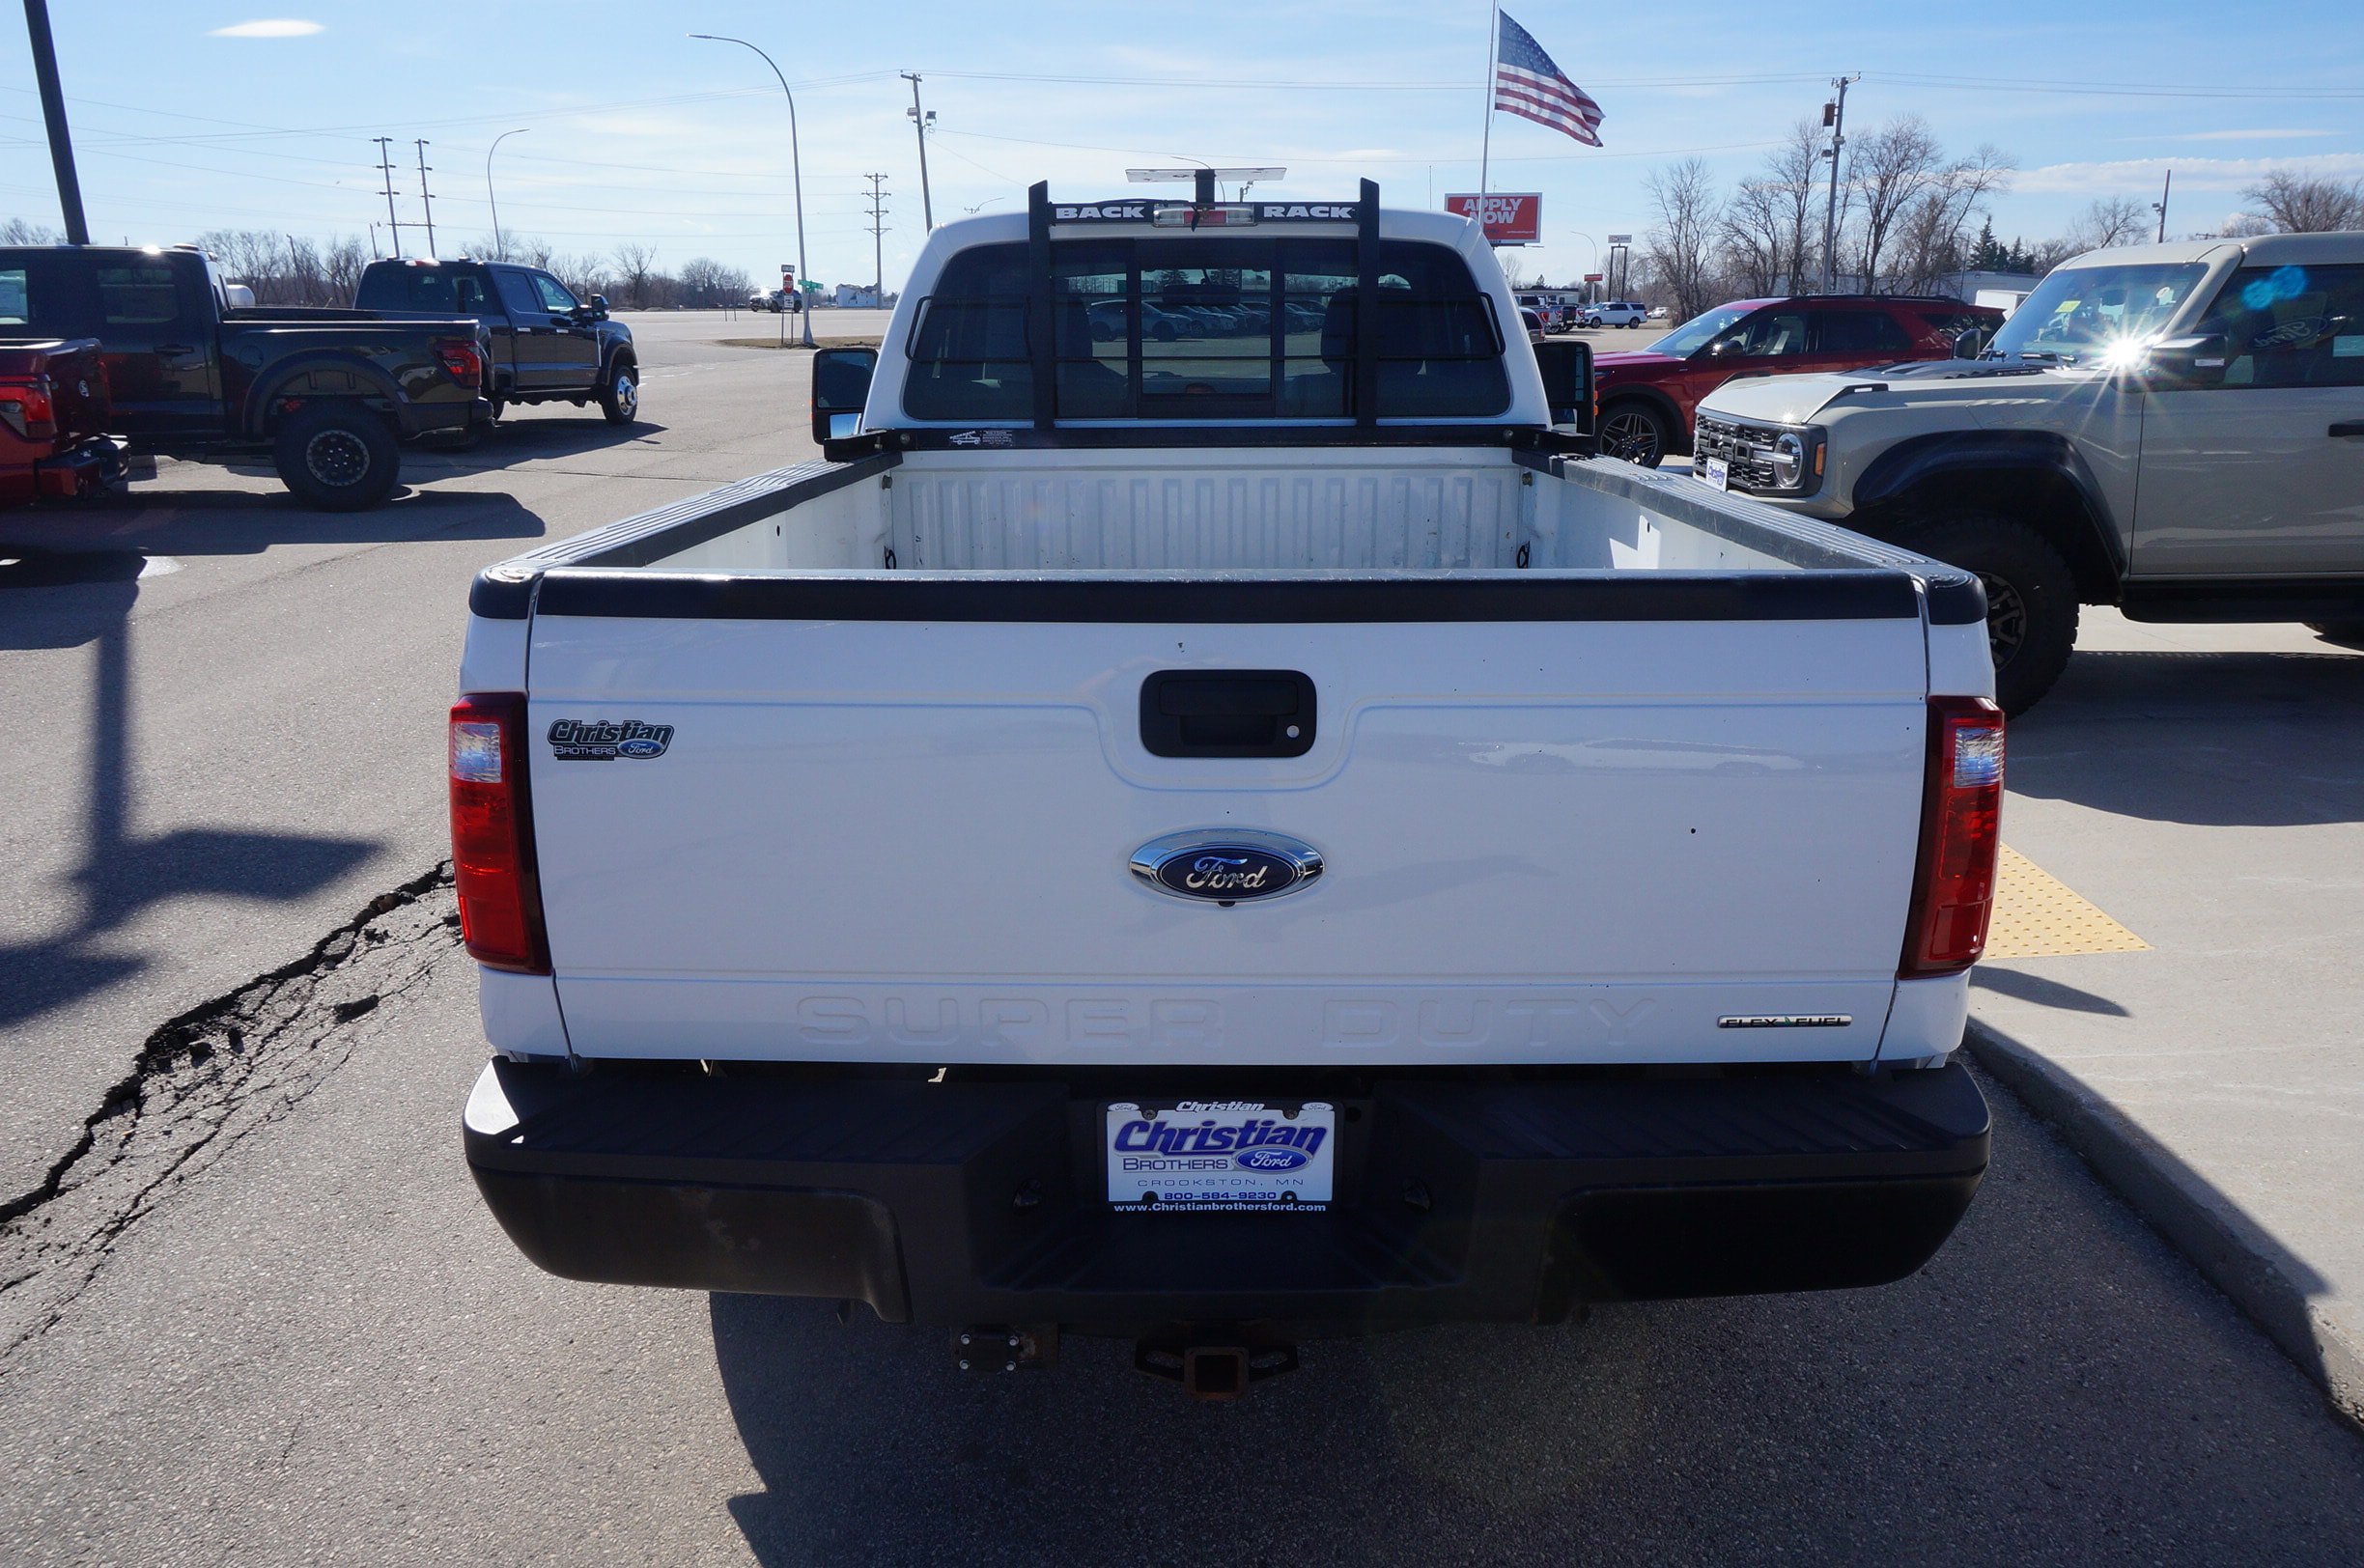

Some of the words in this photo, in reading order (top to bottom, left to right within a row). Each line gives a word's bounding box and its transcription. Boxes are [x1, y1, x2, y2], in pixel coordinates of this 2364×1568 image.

[1463, 198, 1523, 211] APPLY
[1055, 206, 1145, 219] BACK
[1263, 206, 1353, 219] RACK
[548, 719, 674, 744] Christian
[554, 744, 617, 755] BROTHERS
[628, 742, 654, 754] Ford
[1186, 855, 1269, 889] Ford
[797, 995, 1224, 1048] SUPER
[1321, 997, 1657, 1048] DUTY
[1725, 1018, 1779, 1027] FLEX
[1794, 1017, 1846, 1026] FUEL
[1175, 1101, 1265, 1112] Christian
[1113, 1119, 1329, 1156] Christian
[1122, 1158, 1228, 1170] BROTHERS
[1250, 1150, 1294, 1167] Ford
[1164, 1191, 1278, 1200] 800-584-9230
[1113, 1202, 1327, 1212] www.Christianbrothersford.com
